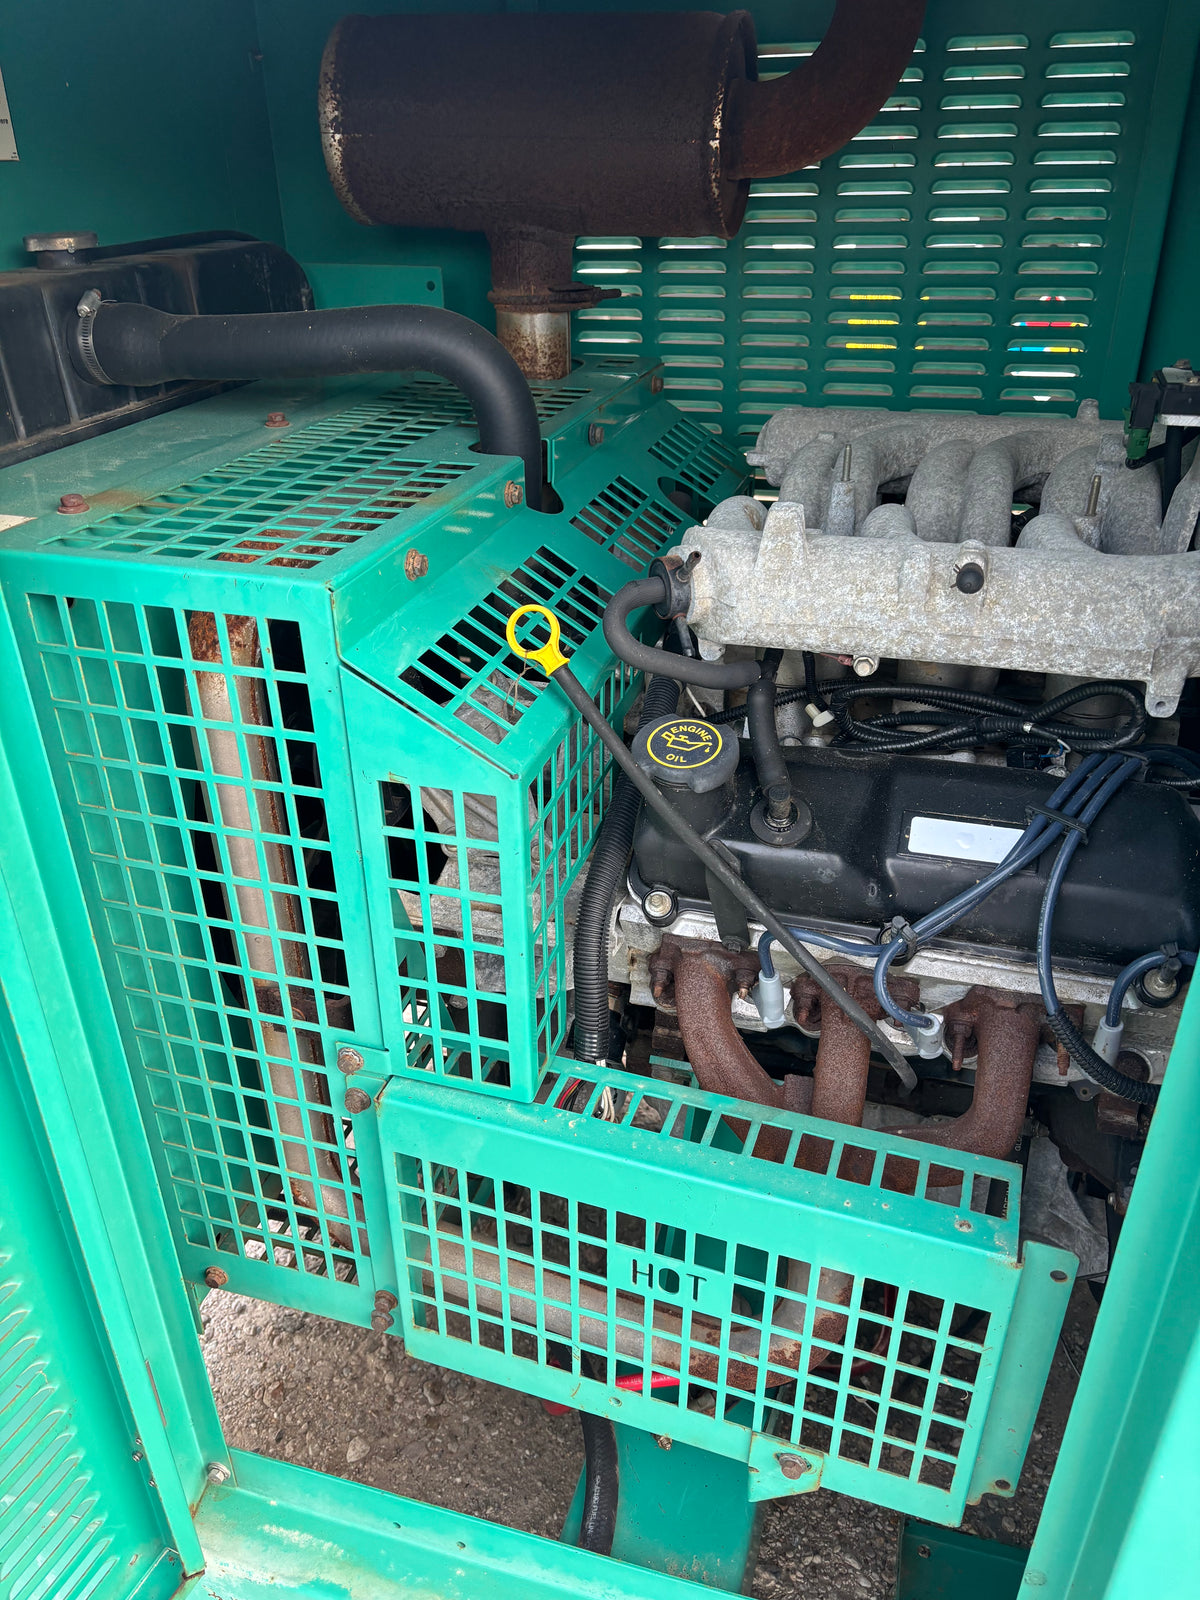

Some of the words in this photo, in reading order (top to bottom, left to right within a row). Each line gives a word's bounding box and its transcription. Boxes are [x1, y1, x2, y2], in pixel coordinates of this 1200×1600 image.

[670, 725, 713, 741] ENGINE
[665, 753, 687, 763] OIL
[632, 1258, 708, 1302] HOT
